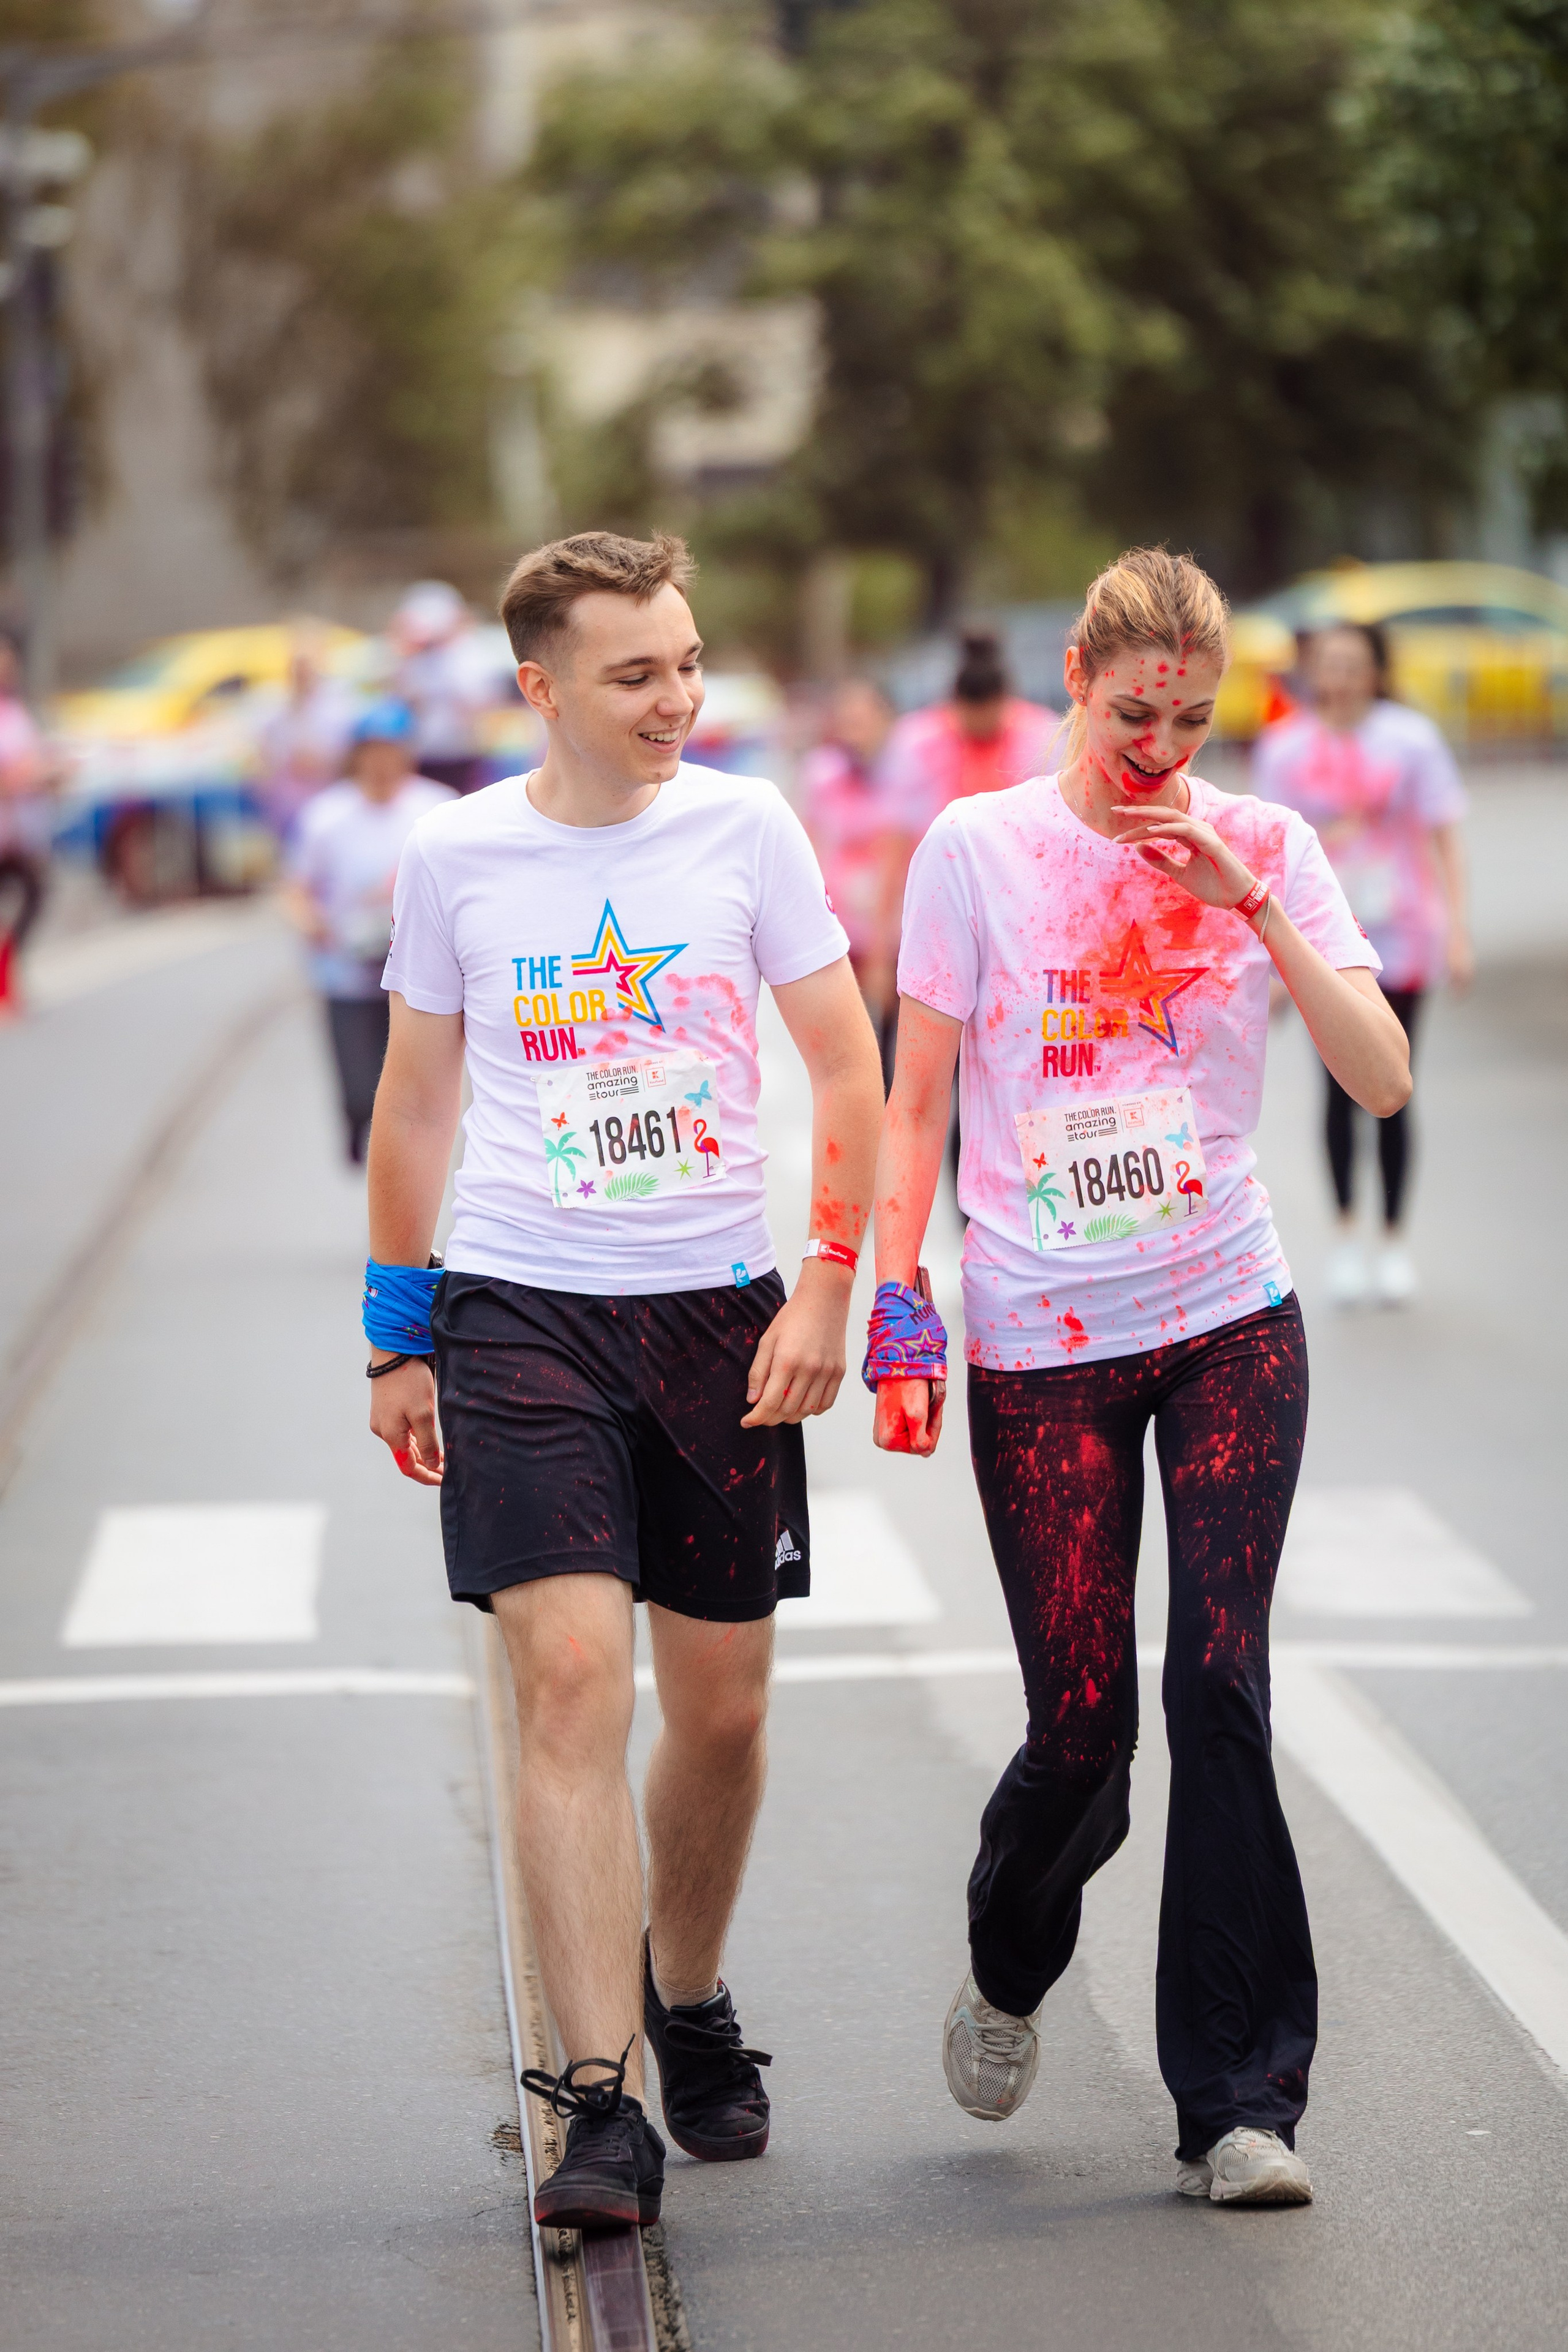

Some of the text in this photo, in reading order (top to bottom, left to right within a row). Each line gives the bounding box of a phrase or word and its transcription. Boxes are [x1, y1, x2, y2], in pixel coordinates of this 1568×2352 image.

[512, 956, 562, 990] THE
[1042, 970, 1091, 1003] THE
[513, 990, 606, 1027] COLOR
[1042, 1008, 1128, 1041] COLOR
[520, 1027, 578, 1061] RUN
[1042, 1043, 1093, 1078] RUN
[586, 1071, 599, 1081] THE
[600, 1068, 622, 1079] COLOR
[587, 1076, 638, 1090] amazing
[597, 1090, 619, 1099] tour
[1064, 1112, 1077, 1122] THE
[1078, 1108, 1100, 1120] COLOR
[1066, 1117, 1116, 1131] amazing
[589, 1106, 681, 1167] 18461
[1074, 1131, 1097, 1140] tour
[1068, 1148, 1164, 1208] 18460
